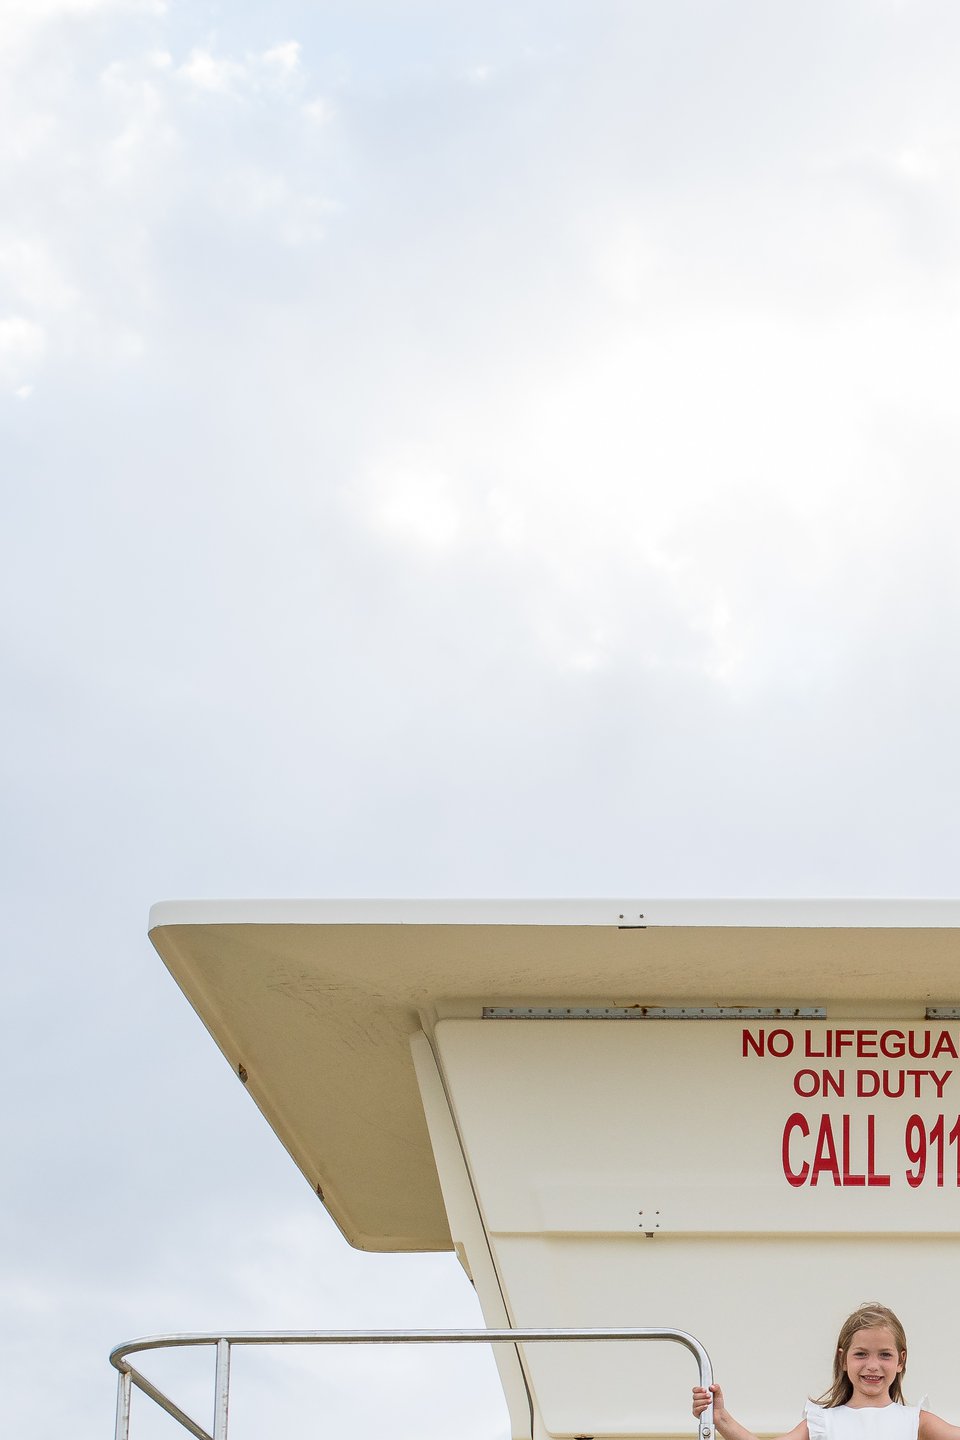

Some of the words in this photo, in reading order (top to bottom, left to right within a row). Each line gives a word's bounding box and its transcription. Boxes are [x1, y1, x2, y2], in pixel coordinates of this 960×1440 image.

[741, 1029, 794, 1057] NO
[793, 1069, 845, 1098] ON
[856, 1069, 953, 1098] DUTY
[781, 1112, 891, 1188] CALL
